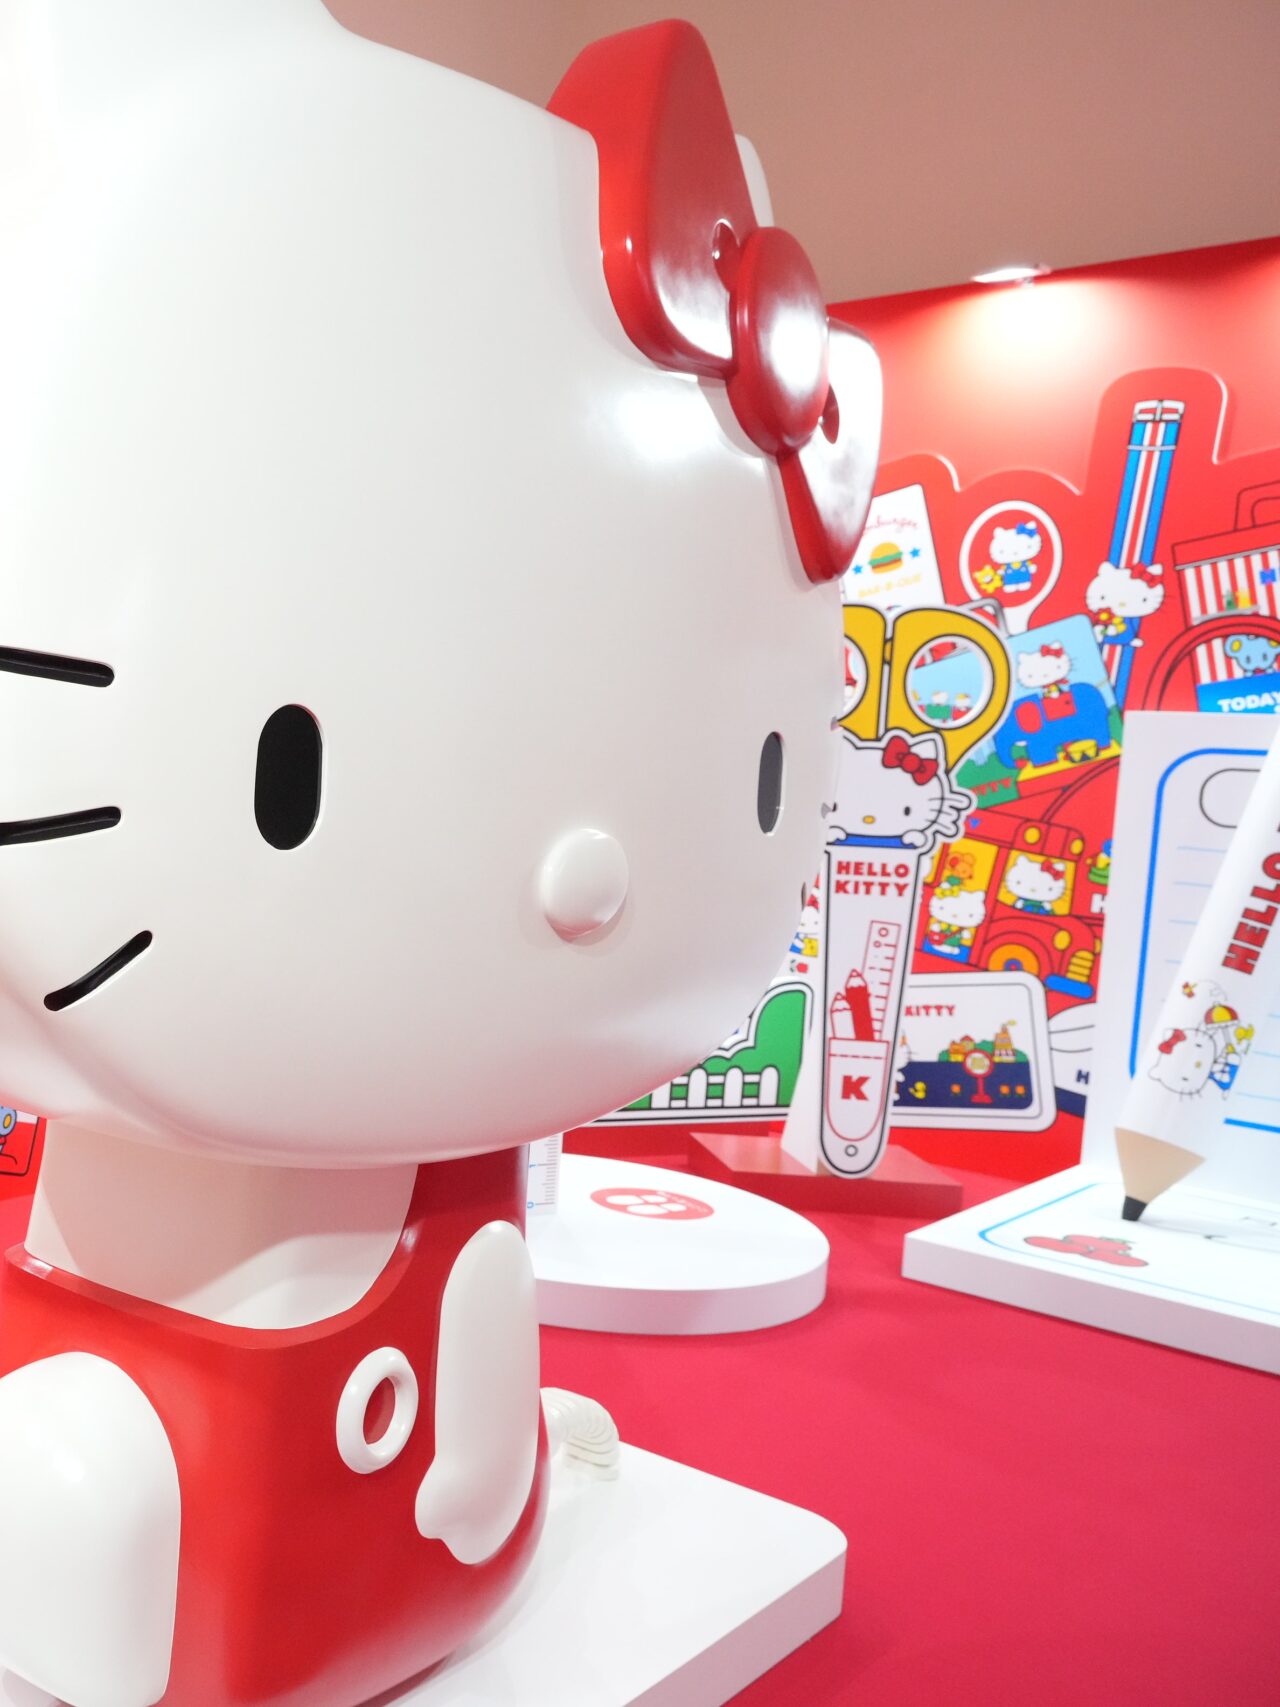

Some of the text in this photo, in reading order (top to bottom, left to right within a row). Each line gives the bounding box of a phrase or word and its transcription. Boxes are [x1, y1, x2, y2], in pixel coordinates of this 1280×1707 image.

[836, 860, 910, 878] HELLO
[834, 880, 909, 897] KITTY
[904, 1004, 956, 1017] KITTY
[841, 1074, 870, 1102] K
